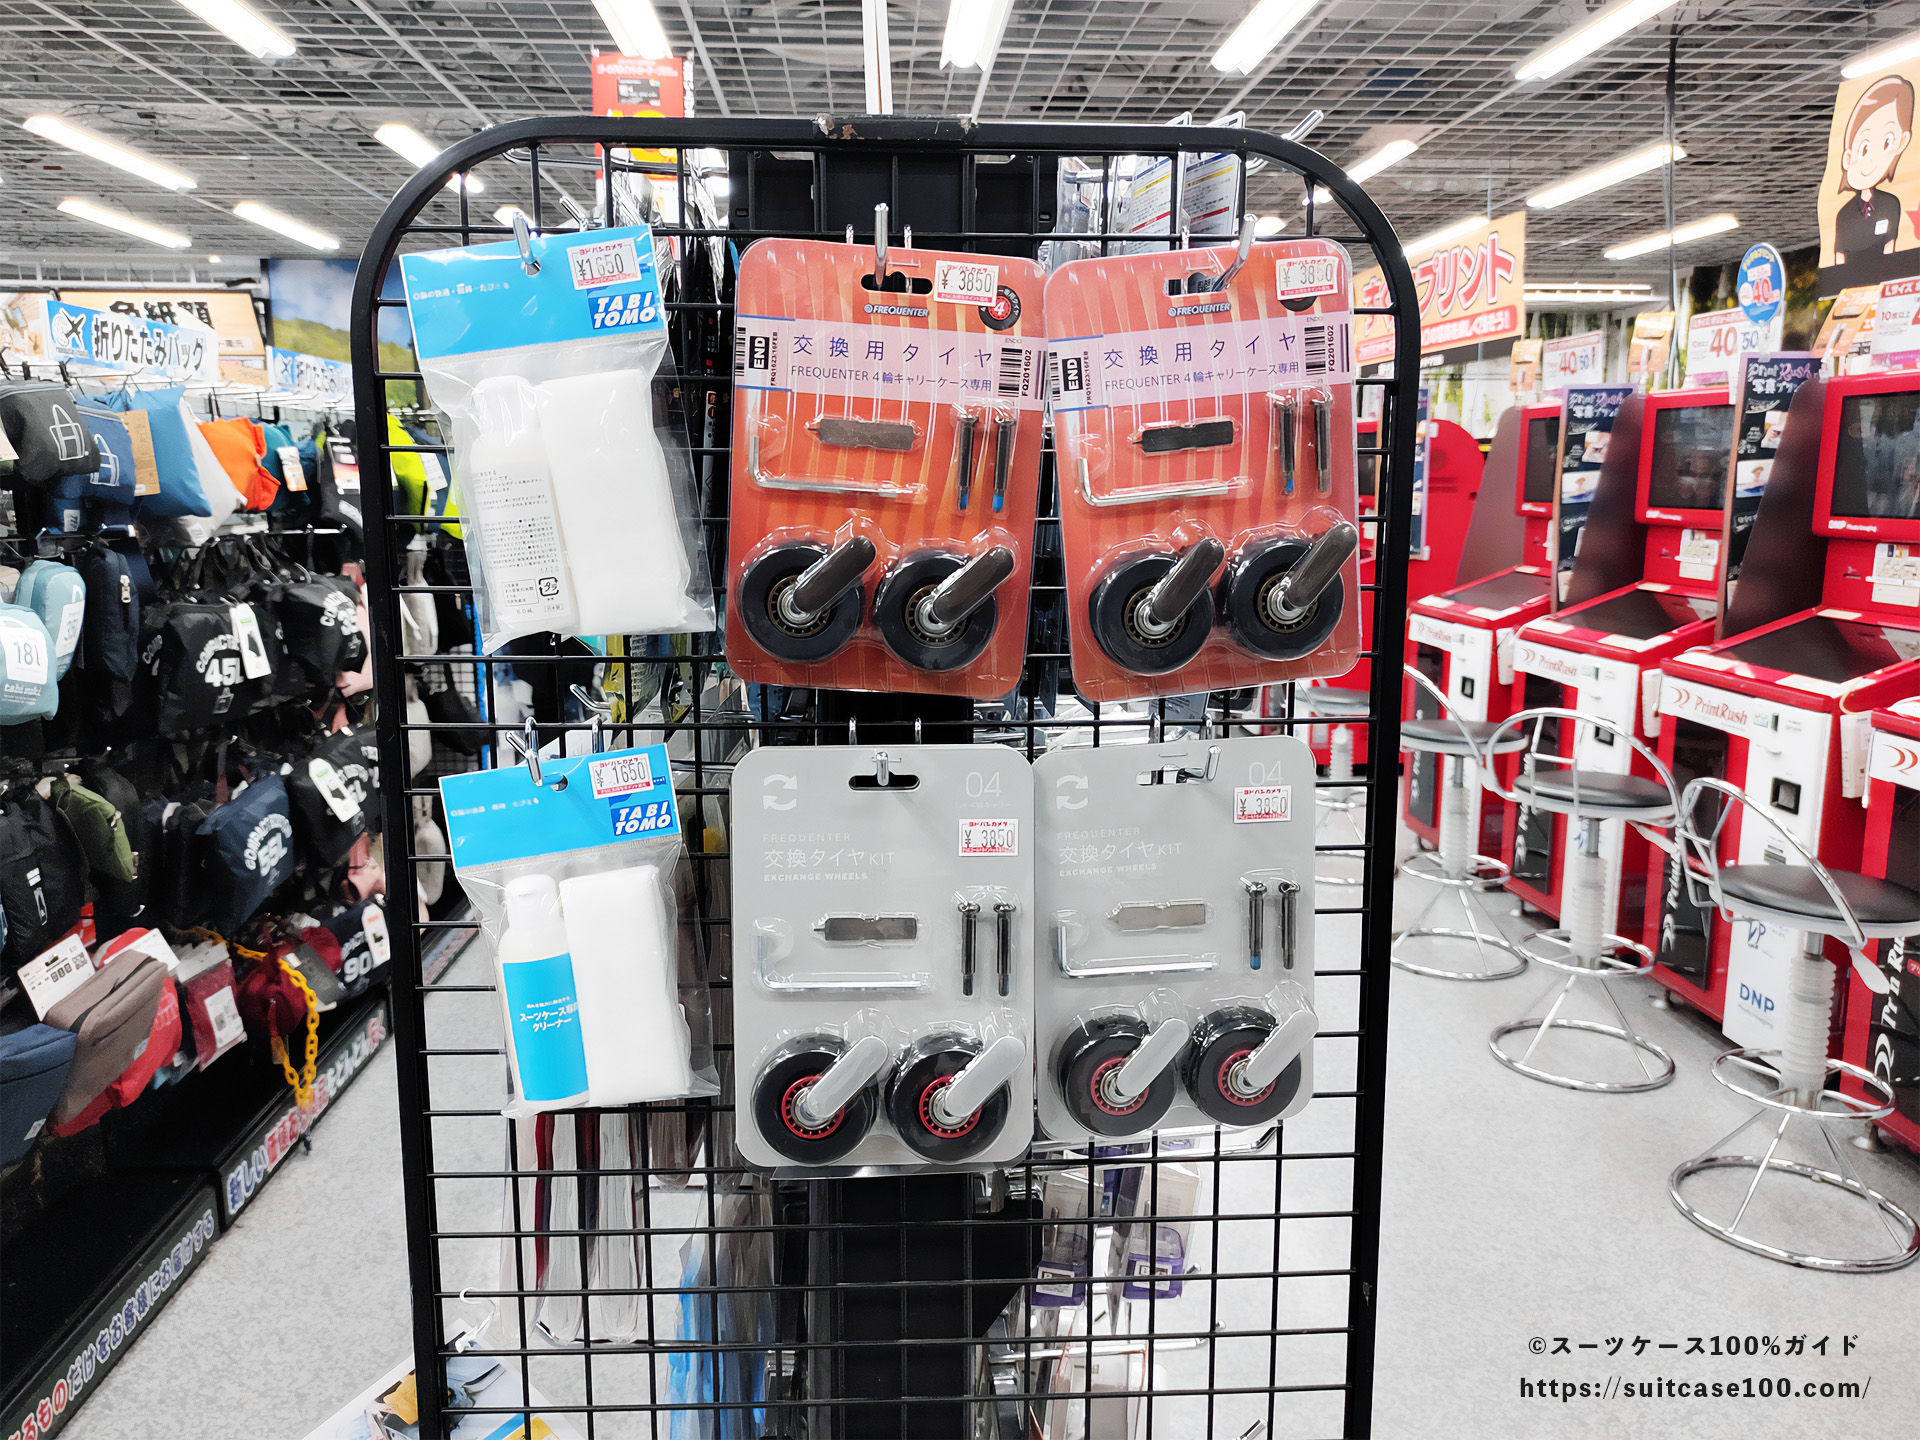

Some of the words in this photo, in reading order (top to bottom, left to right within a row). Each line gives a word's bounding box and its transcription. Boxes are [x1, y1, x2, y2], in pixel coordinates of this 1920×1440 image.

[580, 243, 623, 255] ヨドバシカメラ
[947, 265, 988, 275] ヨドバシカメラ
[597, 291, 653, 313] TABI
[872, 305, 929, 317] FREQUENTER
[994, 302, 1005, 316] 4
[1176, 303, 1231, 316] FREQUENTER
[593, 307, 656, 329] TOMO
[93, 316, 206, 371] 折りたたみバッグ
[792, 334, 992, 368] 交換用タイヤ
[1710, 326, 1738, 358] 40
[1104, 334, 1296, 370] 交換用タイヤ
[791, 365, 869, 381] FREQUENTER
[1105, 373, 1181, 391] FREQUENTER
[204, 658, 245, 687] 45L
[599, 757, 639, 768] ヨドバシカメラ
[1249, 760, 1284, 786] 04
[966, 771, 1002, 798] 04
[619, 801, 669, 821] TABI
[615, 814, 672, 836] TOMO
[1057, 827, 1141, 840] FREQUENTER
[762, 832, 851, 843] FREQUENTER
[763, 872, 821, 882] EXCHANGE
[825, 872, 868, 881] WHEELS
[1059, 867, 1113, 877] EXCHANGE
[1117, 863, 1157, 873] WHEELS
[1740, 983, 1774, 1013] DNP
[532, 1018, 572, 1032] クリーナー
